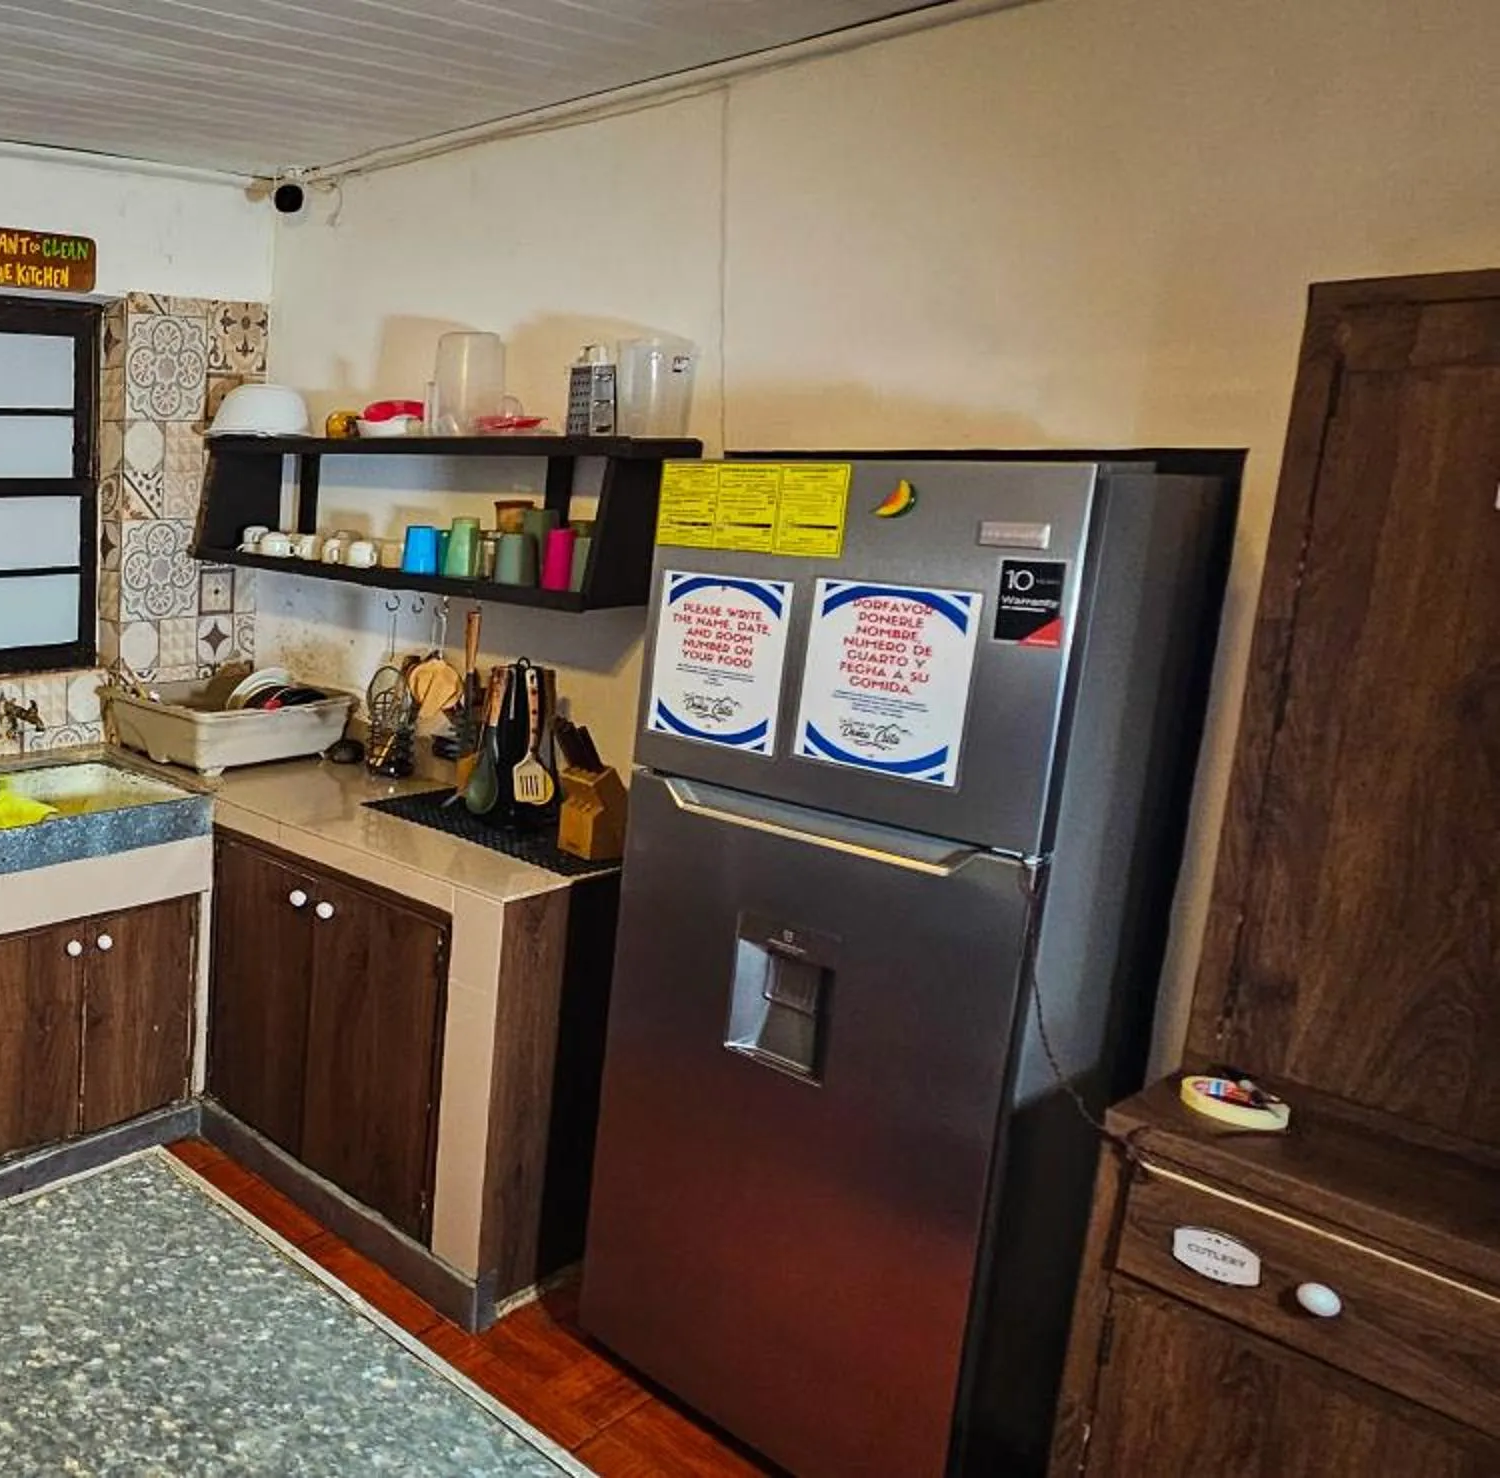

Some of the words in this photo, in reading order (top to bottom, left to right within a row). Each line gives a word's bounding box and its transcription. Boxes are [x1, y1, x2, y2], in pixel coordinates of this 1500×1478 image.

[43, 238, 89, 260] CLEAN
[16, 263, 69, 287] KITCHEN
[1005, 569, 1035, 592] 10
[673, 613, 692, 625] THE
[683, 603, 722, 616] PLEASE
[727, 608, 763, 621] WRITE
[858, 611, 925, 629] PONERLE
[686, 628, 712, 639] AND
[715, 631, 753, 645] ROOM
[843, 636, 907, 654] NUMERO
[913, 645, 933, 657] DE
[683, 639, 731, 653] NUMBER
[734, 645, 754, 657] ON
[682, 650, 714, 662] YOUR
[718, 656, 753, 669] FOOD
[847, 649, 909, 667] CUARTO
[915, 659, 926, 669] Y
[839, 661, 887, 677] FECHA
[892, 669, 905, 680] A
[910, 672, 930, 684] SU
[1187, 1243, 1247, 1268] CUTLERY
